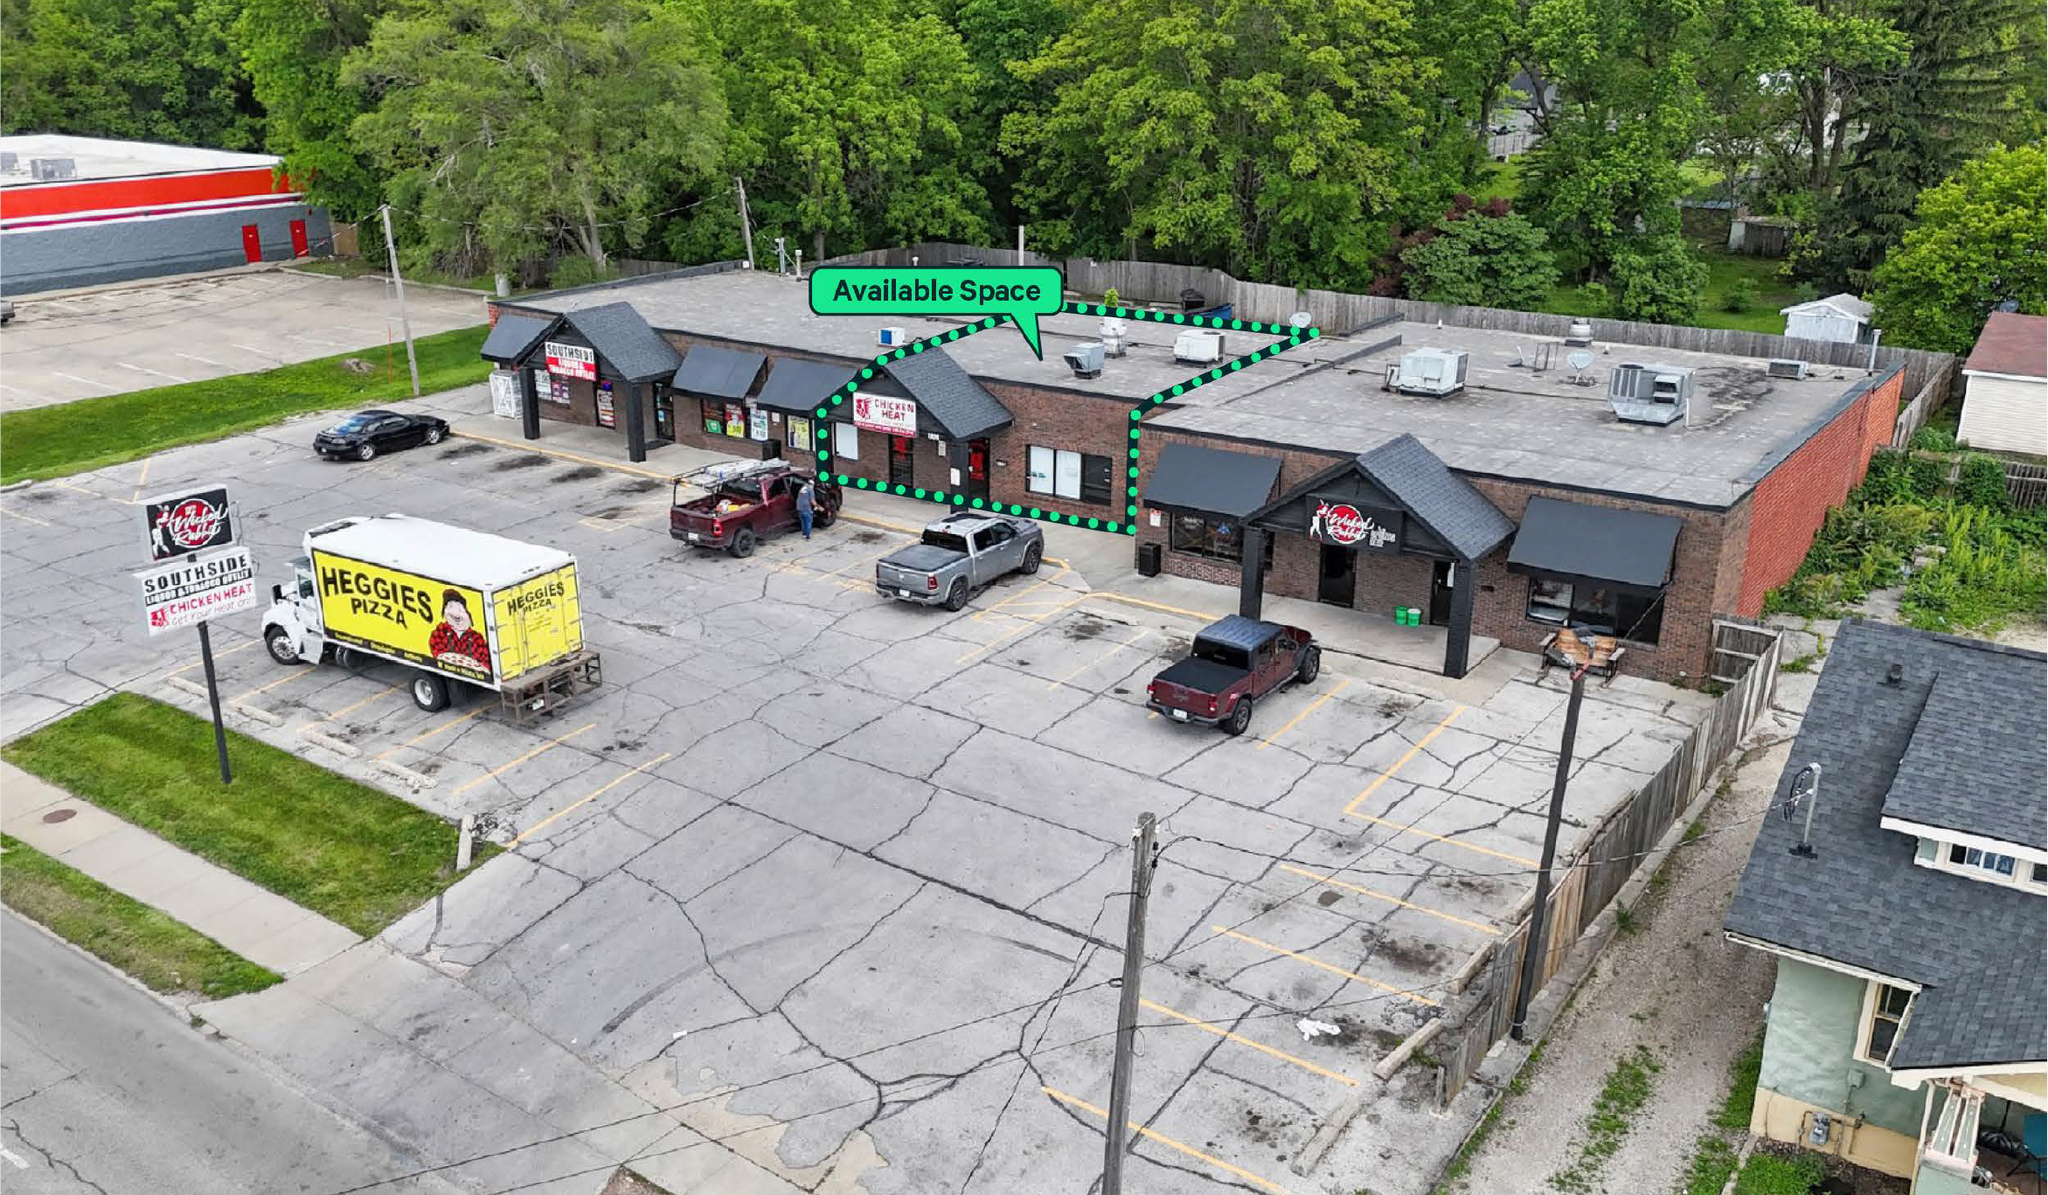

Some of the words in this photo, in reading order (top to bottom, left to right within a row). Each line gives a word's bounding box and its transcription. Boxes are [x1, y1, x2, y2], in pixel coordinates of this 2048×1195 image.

[874, 399, 914, 413] CHICKEN
[882, 410, 905, 421] HEAT
[168, 503, 229, 532] Wicked
[144, 555, 248, 593] SOUTHSIDE
[170, 592, 221, 614] CHICKEN
[224, 583, 253, 599] HEAT
[322, 567, 433, 623] HEGGIES
[507, 582, 565, 616] HEGGIES
[522, 599, 552, 613] PIZZA
[350, 597, 408, 629] PIZZA
